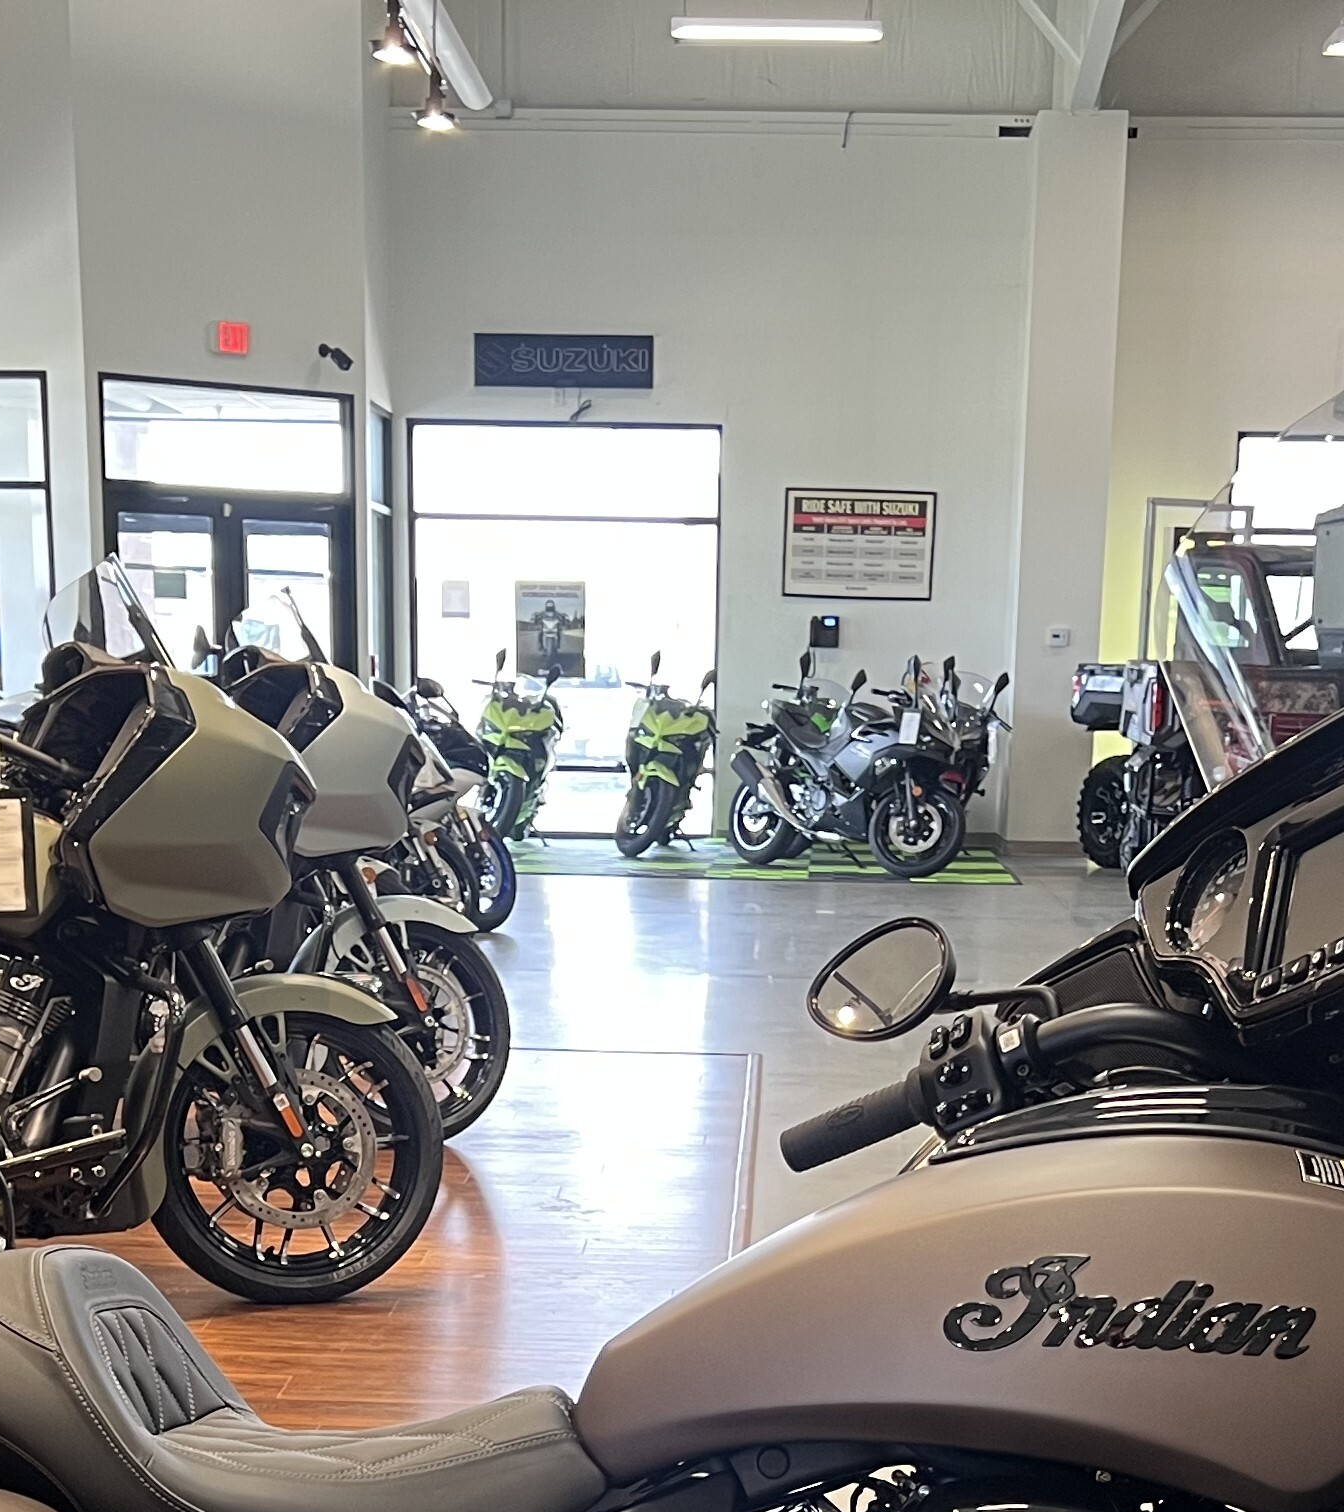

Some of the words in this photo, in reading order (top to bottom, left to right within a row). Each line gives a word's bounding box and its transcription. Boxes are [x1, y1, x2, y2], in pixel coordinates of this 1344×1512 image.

[509, 346, 650, 374] SUZUKI
[801, 498, 826, 513] RIDE
[827, 499, 853, 514] SAFE
[854, 500, 881, 515] WITH
[882, 501, 920, 516] SUZUKI
[942, 1253, 1317, 1360] Indian
